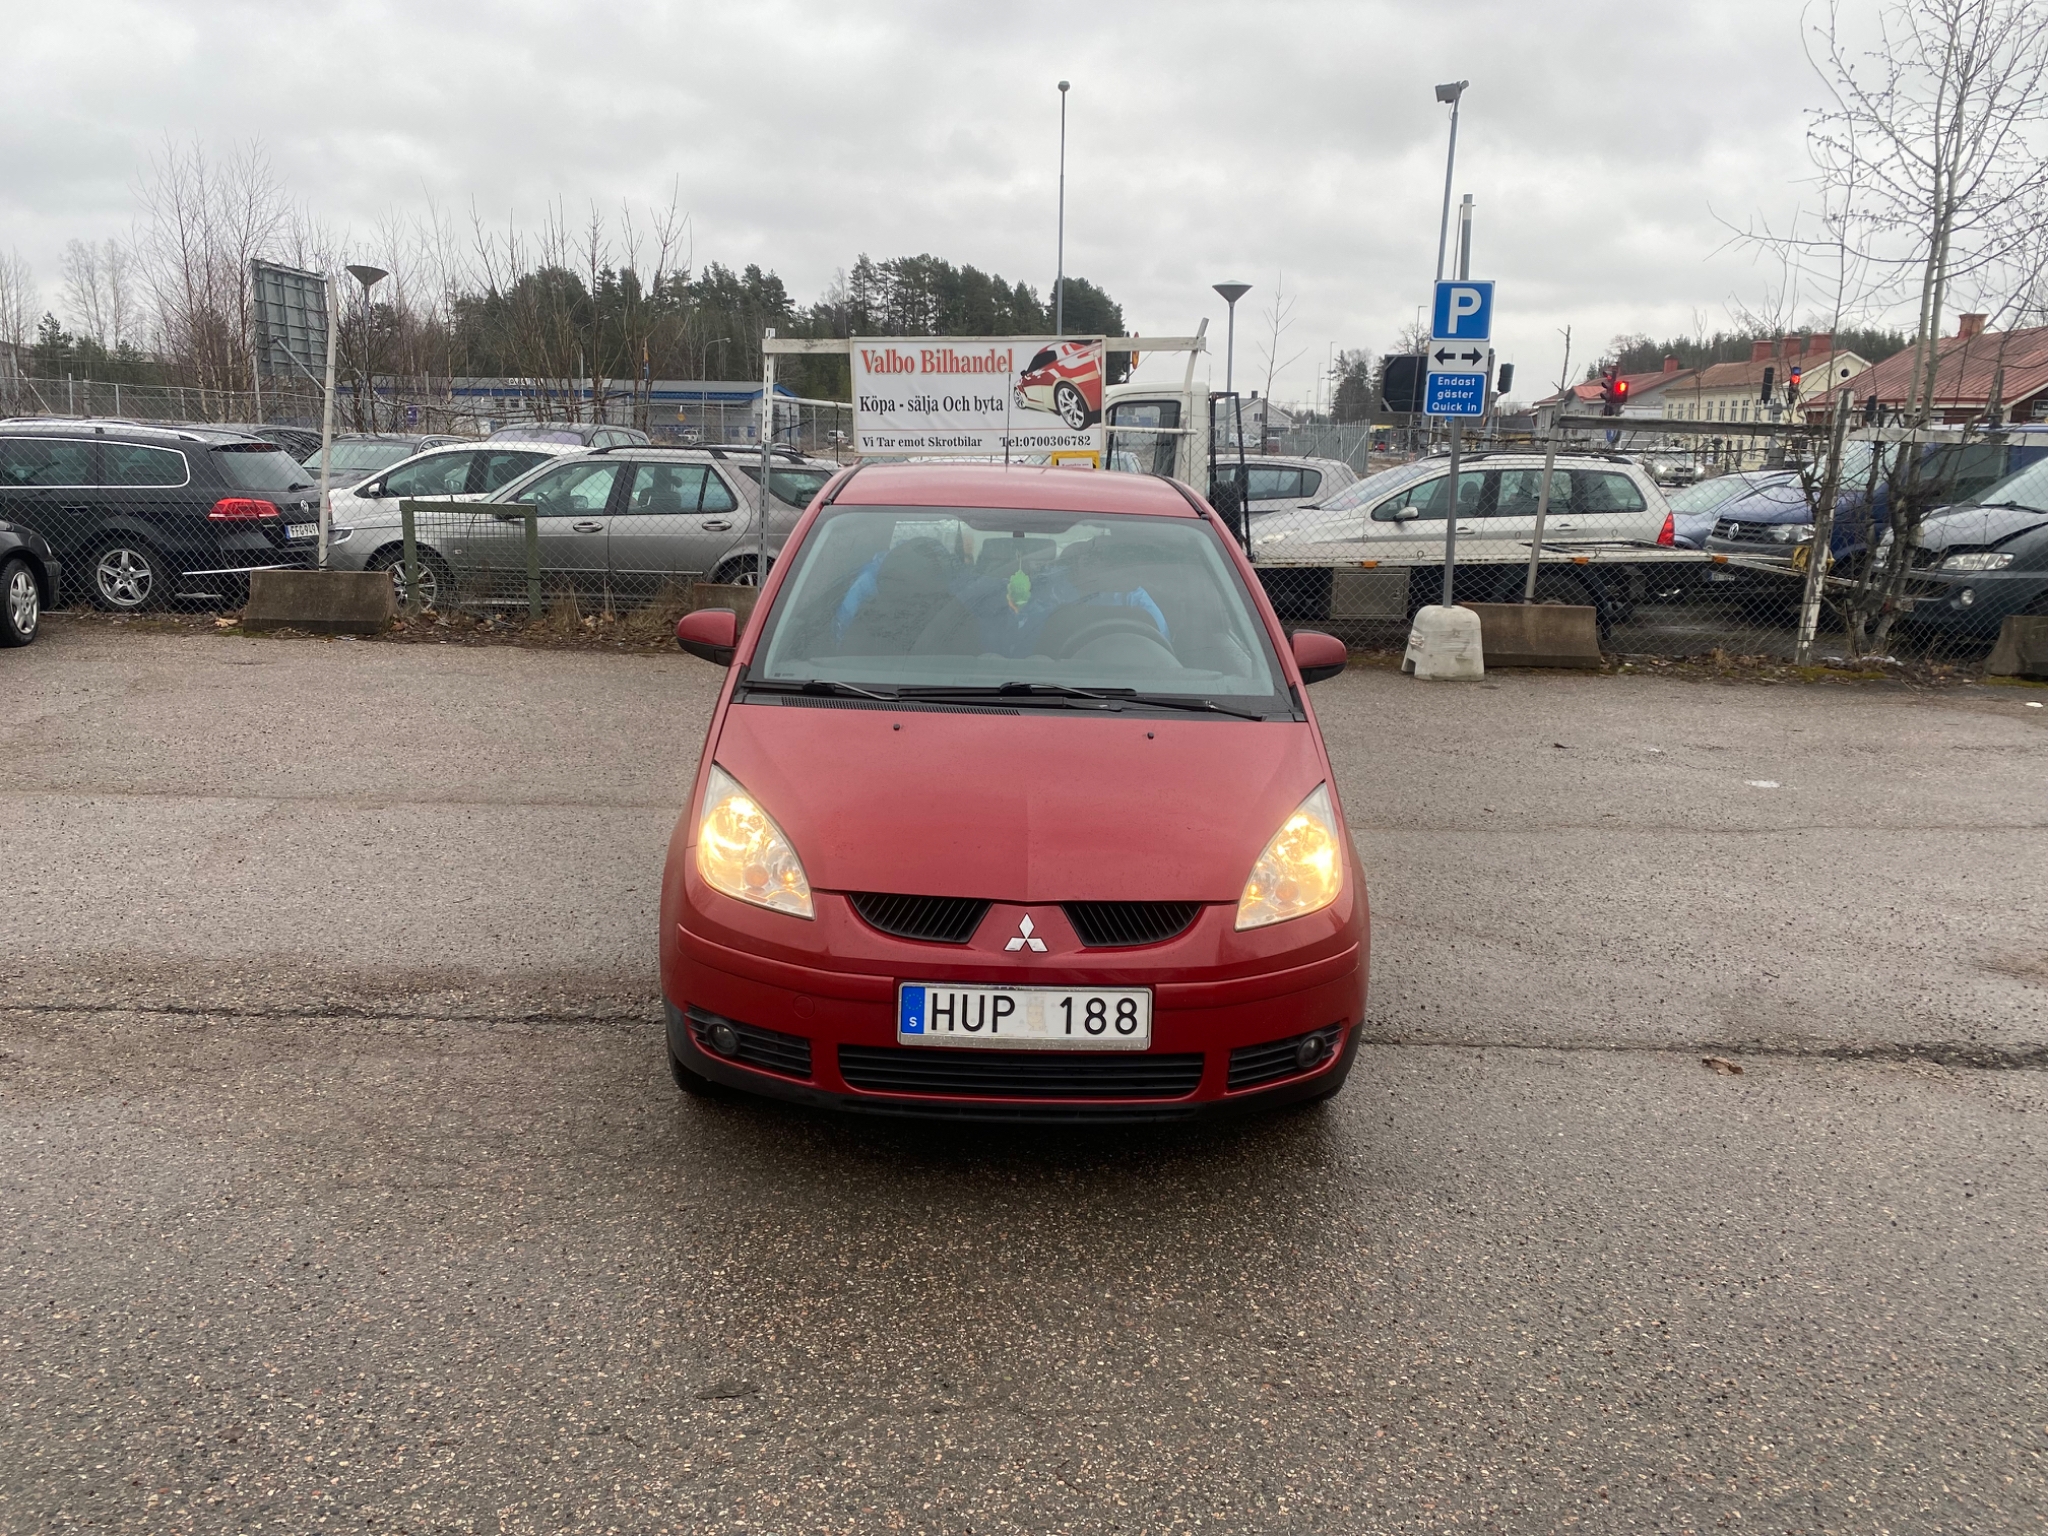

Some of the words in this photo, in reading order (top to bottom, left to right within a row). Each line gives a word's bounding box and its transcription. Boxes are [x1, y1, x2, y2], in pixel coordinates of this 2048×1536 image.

[1447, 287, 1482, 334] P
[861, 349, 915, 374] Valbo
[920, 347, 1014, 374] Bilhandel
[1437, 376, 1476, 386] Endast
[1437, 388, 1474, 400] gäster
[859, 394, 896, 415] Köpa
[907, 394, 939, 415] sälja
[943, 395, 971, 412] Och
[973, 396, 1004, 415] byta
[1431, 401, 1463, 412] Quick
[1467, 401, 1477, 412] in
[863, 436, 874, 448] Vi
[876, 436, 896, 448] Tar
[898, 437, 925, 448] emot
[928, 435, 983, 448] Skrotbilar
[909, 1016, 918, 1027] S
[931, 992, 1016, 1034] HUP
[1059, 995, 1138, 1035] 188
